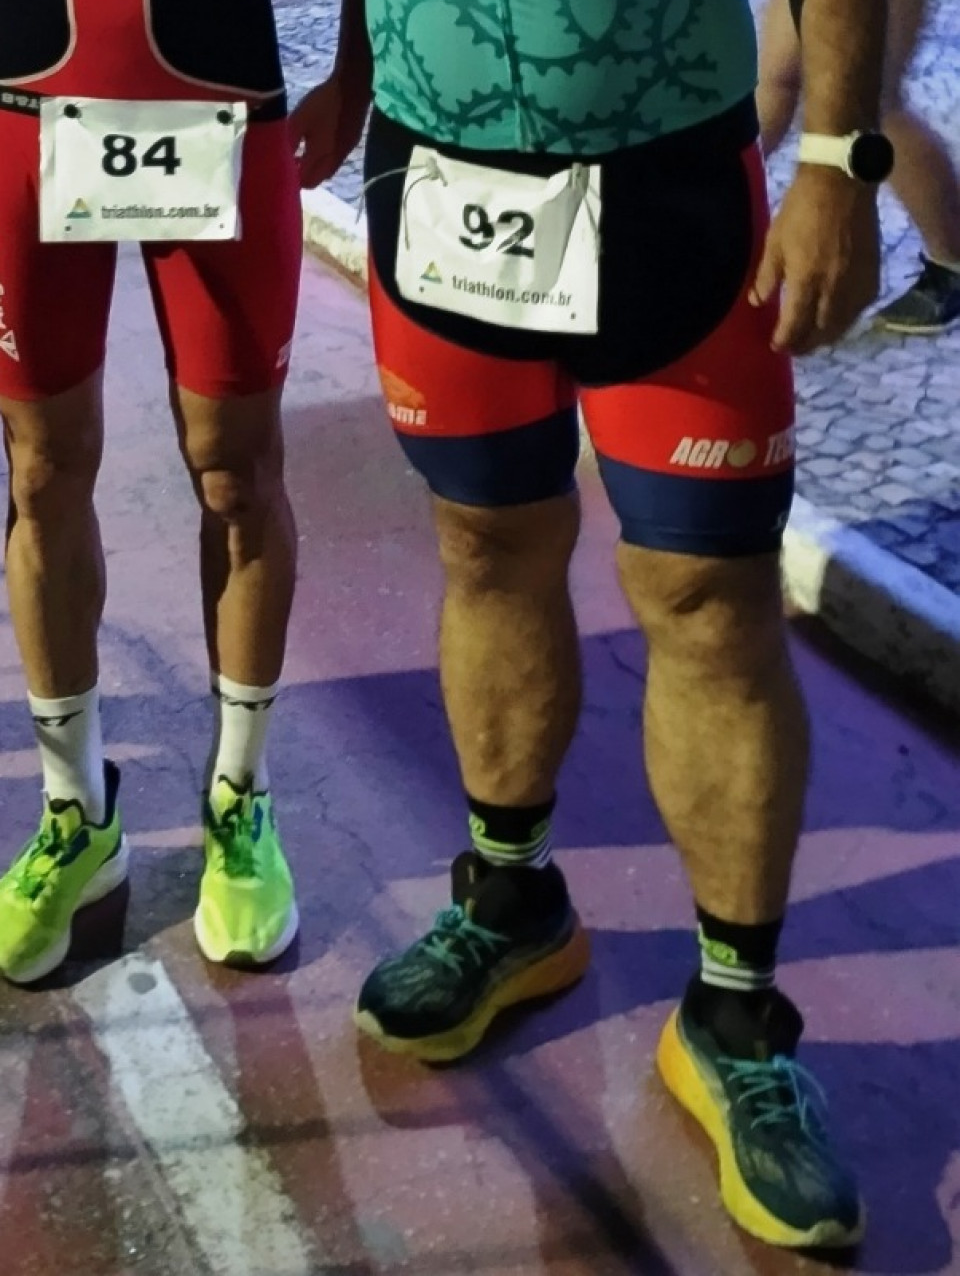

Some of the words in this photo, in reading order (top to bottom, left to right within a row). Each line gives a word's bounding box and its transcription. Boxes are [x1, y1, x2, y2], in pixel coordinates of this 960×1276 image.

[101, 134, 181, 177] 84
[101, 204, 220, 219] triathlon.com.br
[458, 203, 535, 258] 92
[451, 275, 573, 306] triathlon.com.br
